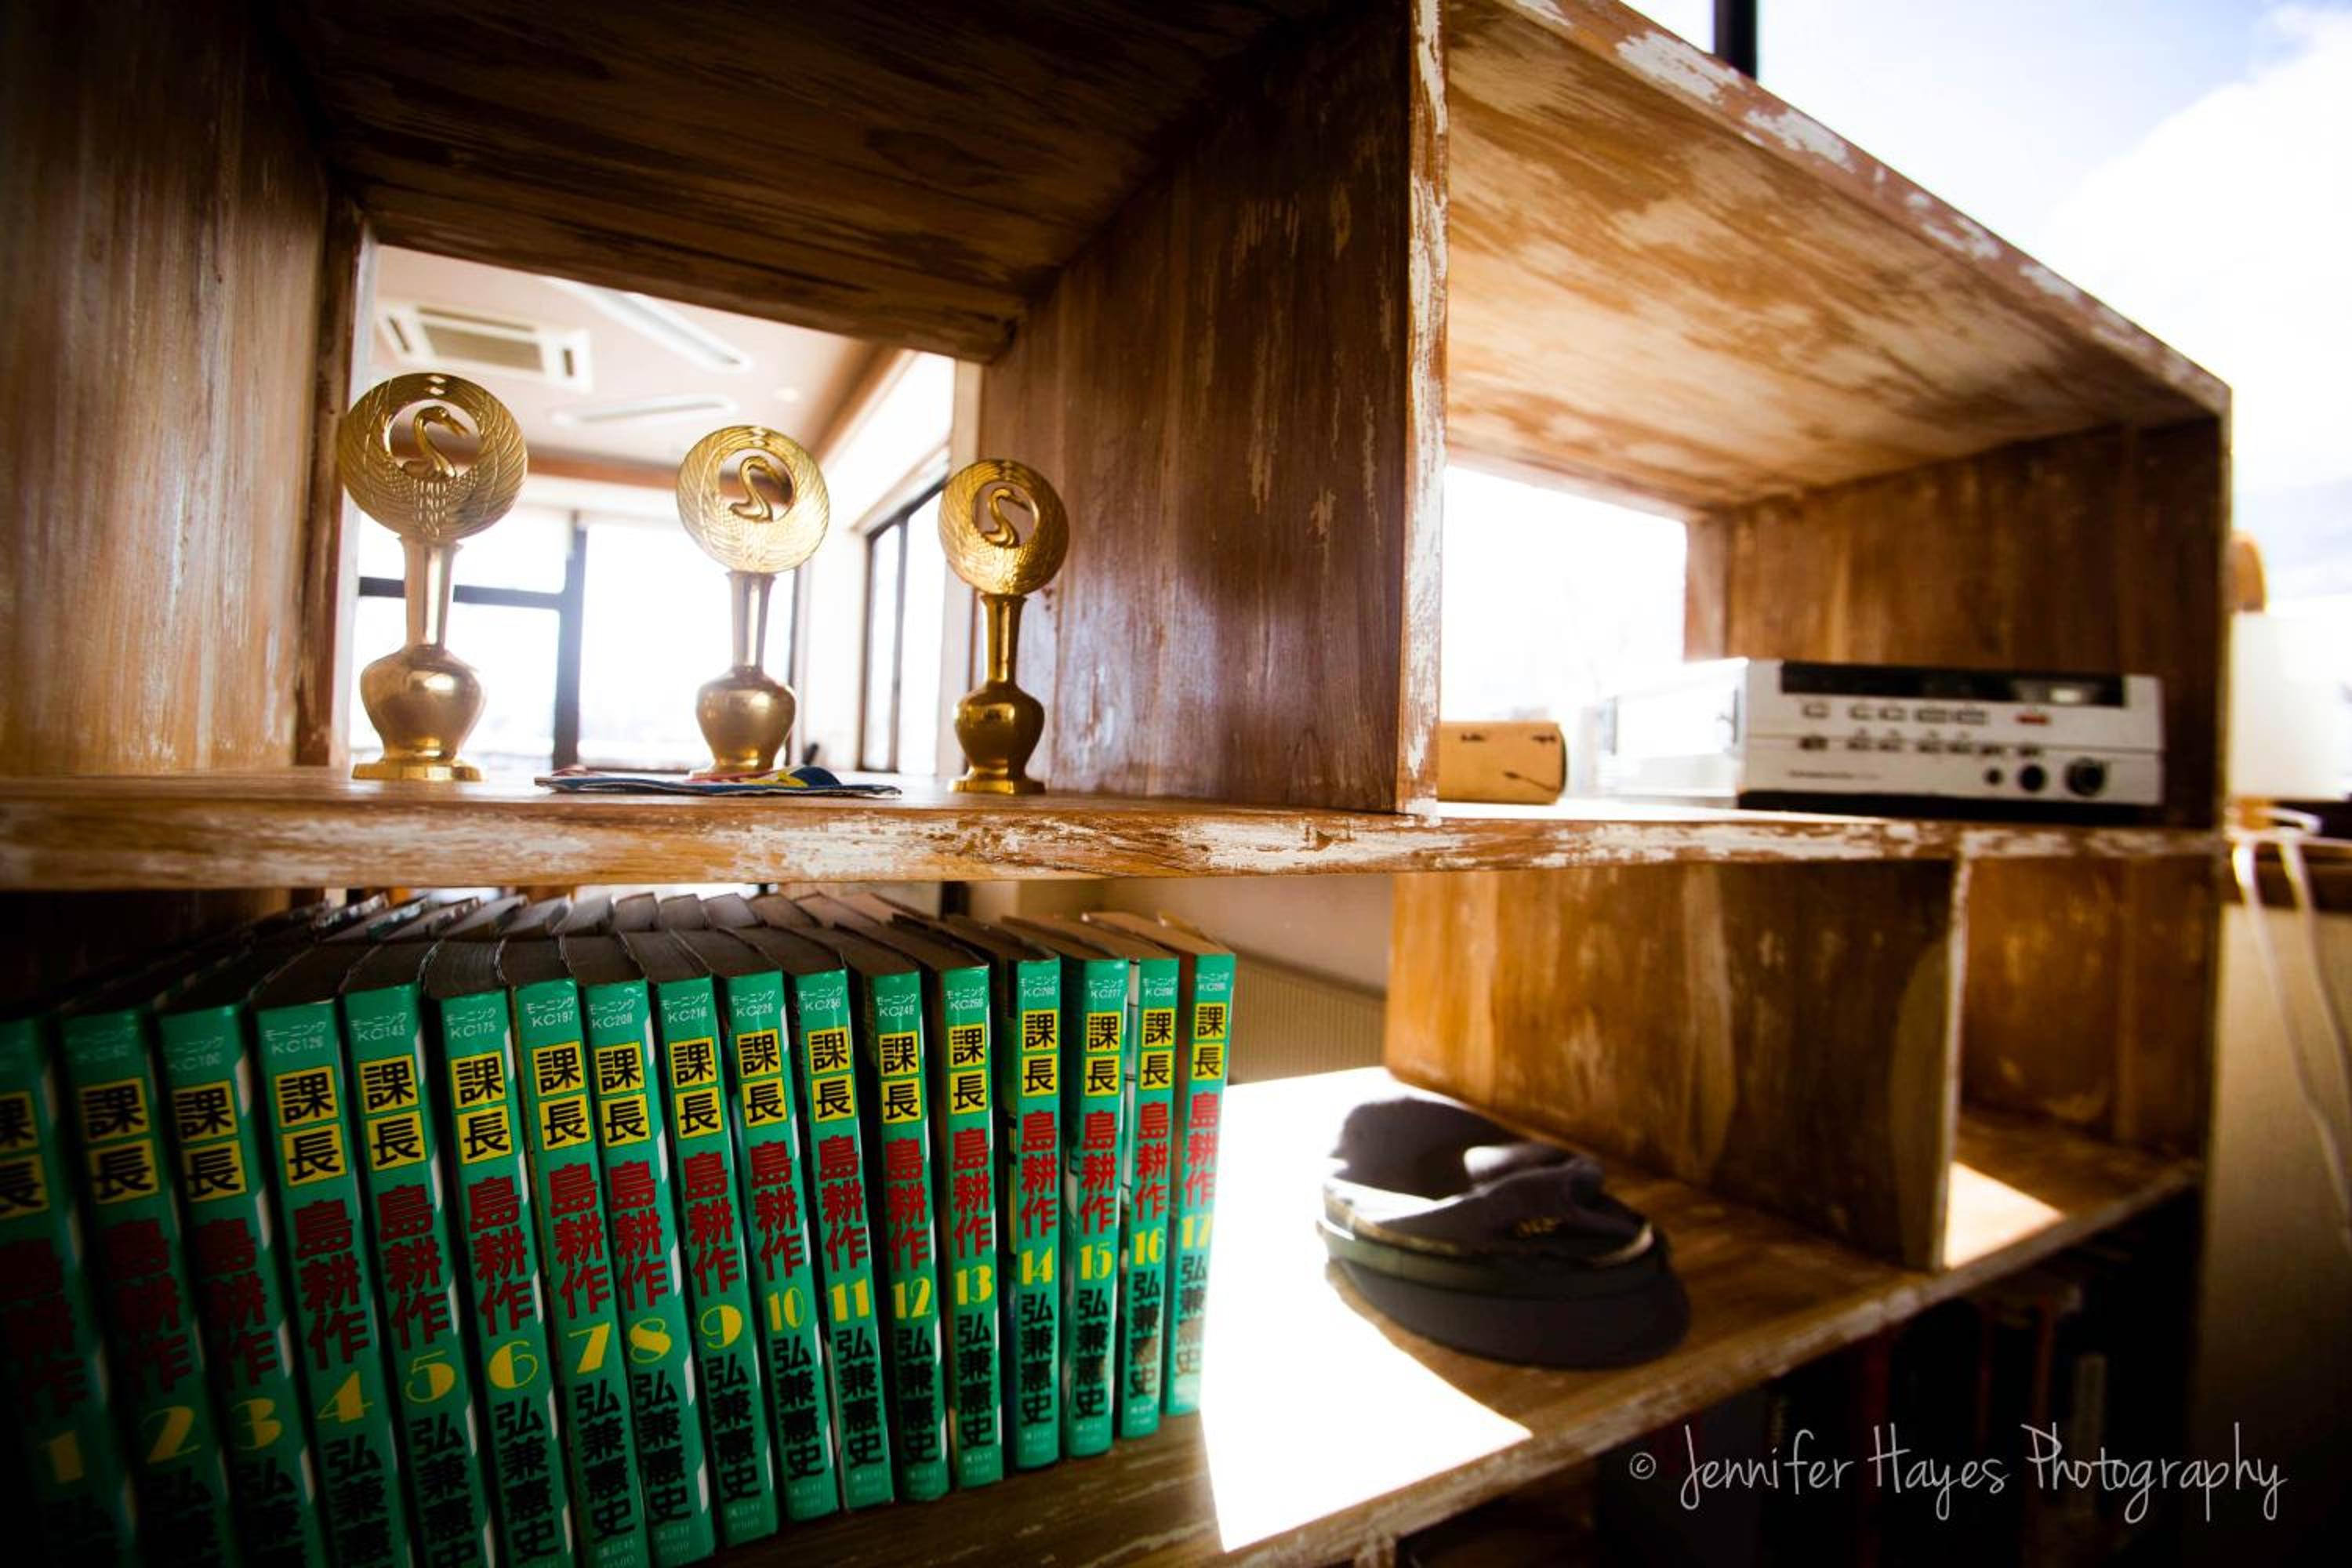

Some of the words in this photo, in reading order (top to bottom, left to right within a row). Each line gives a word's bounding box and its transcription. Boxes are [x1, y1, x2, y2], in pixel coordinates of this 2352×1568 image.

[446, 1007, 496, 1024] モーニング
[526, 996, 575, 1014] モーニング
[590, 999, 636, 1015] モーニング
[661, 993, 709, 1010] モーニング
[731, 990, 775, 1004] モーニング
[800, 986, 844, 1000] モーニング
[877, 993, 916, 1006] モーニング
[946, 986, 985, 1000] モーニング
[1020, 976, 1057, 987] モーニング
[1088, 980, 1123, 989] モーニング
[1143, 976, 1177, 986] モーニング
[263, 1022, 327, 1041] モーニング
[350, 1011, 408, 1029] モーニング
[1025, 1013, 1055, 1094] 課長
[1087, 1014, 1119, 1094] 課長
[1143, 1011, 1173, 1087] 課長
[1194, 1005, 1225, 1077] 課長
[536, 1047, 587, 1145] 課長
[598, 1047, 646, 1143] 課長
[673, 1043, 718, 1135] 課長
[739, 1033, 783, 1124] 課長
[811, 1030, 852, 1120] 課長
[881, 1035, 918, 1123] 課長
[951, 1027, 985, 1111] 課長
[280, 1072, 340, 1181] 課長
[363, 1061, 420, 1166] 課長
[456, 1056, 509, 1159] 課長
[1021, 1109, 1057, 1239] 島耕作
[1080, 1109, 1116, 1236] 島耕作
[1134, 1102, 1169, 1222] 島耕作
[1184, 1091, 1218, 1209] 島耕作
[683, 1151, 739, 1297] 島耕作
[750, 1141, 804, 1281] 島耕作
[818, 1134, 868, 1272] 島耕作
[885, 1138, 930, 1272] 島耕作
[953, 1127, 992, 1258] 島耕作
[470, 1176, 534, 1336] 島耕作
[549, 1163, 610, 1319] 島耕作
[608, 1160, 668, 1311] 島耕作
[1021, 1247, 1054, 1285] 14
[1080, 1241, 1113, 1279] 15
[1134, 1227, 1166, 1266] 16
[1181, 1213, 1213, 1249] 17
[85, 1085, 151, 1200] 課長
[139, 1405, 201, 1466] 2
[175, 1088, 239, 1196] 課長
[227, 1397, 283, 1452] 3
[294, 1200, 371, 1370] 島耕作
[377, 1185, 449, 1352] 島耕作
[829, 1279, 870, 1323] 11
[891, 1277, 931, 1320] 12
[954, 1265, 993, 1305] 13
[630, 1318, 672, 1363] 8
[700, 1305, 742, 1349] 9
[768, 1287, 804, 1330] 10
[405, 1349, 456, 1405] 5
[488, 1339, 539, 1390] 6
[568, 1322, 611, 1374] 7
[315, 1370, 375, 1425] 4
[36, 1428, 85, 1484] 1
